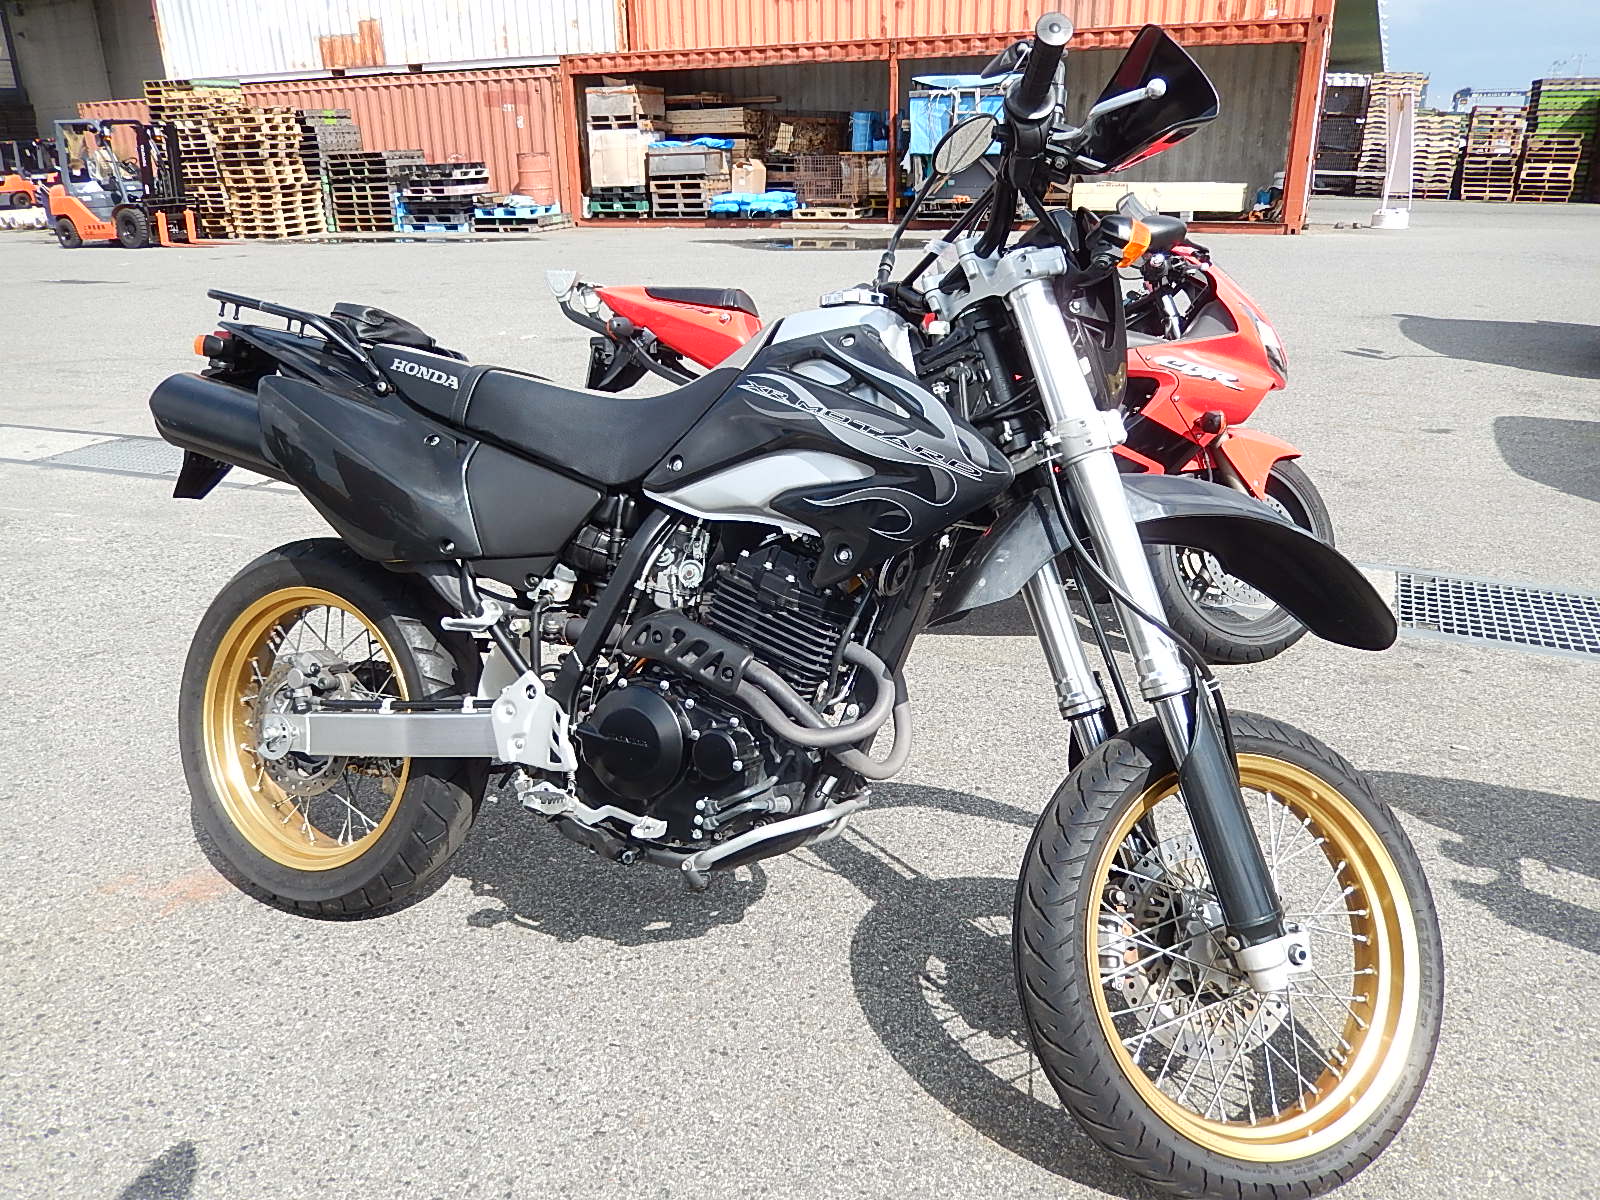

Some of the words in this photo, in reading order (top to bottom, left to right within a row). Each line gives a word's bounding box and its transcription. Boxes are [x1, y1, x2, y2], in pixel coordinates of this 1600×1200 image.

[390, 358, 459, 390] HONDA
[746, 380, 790, 404] XR
[796, 400, 983, 477] MOTARD
